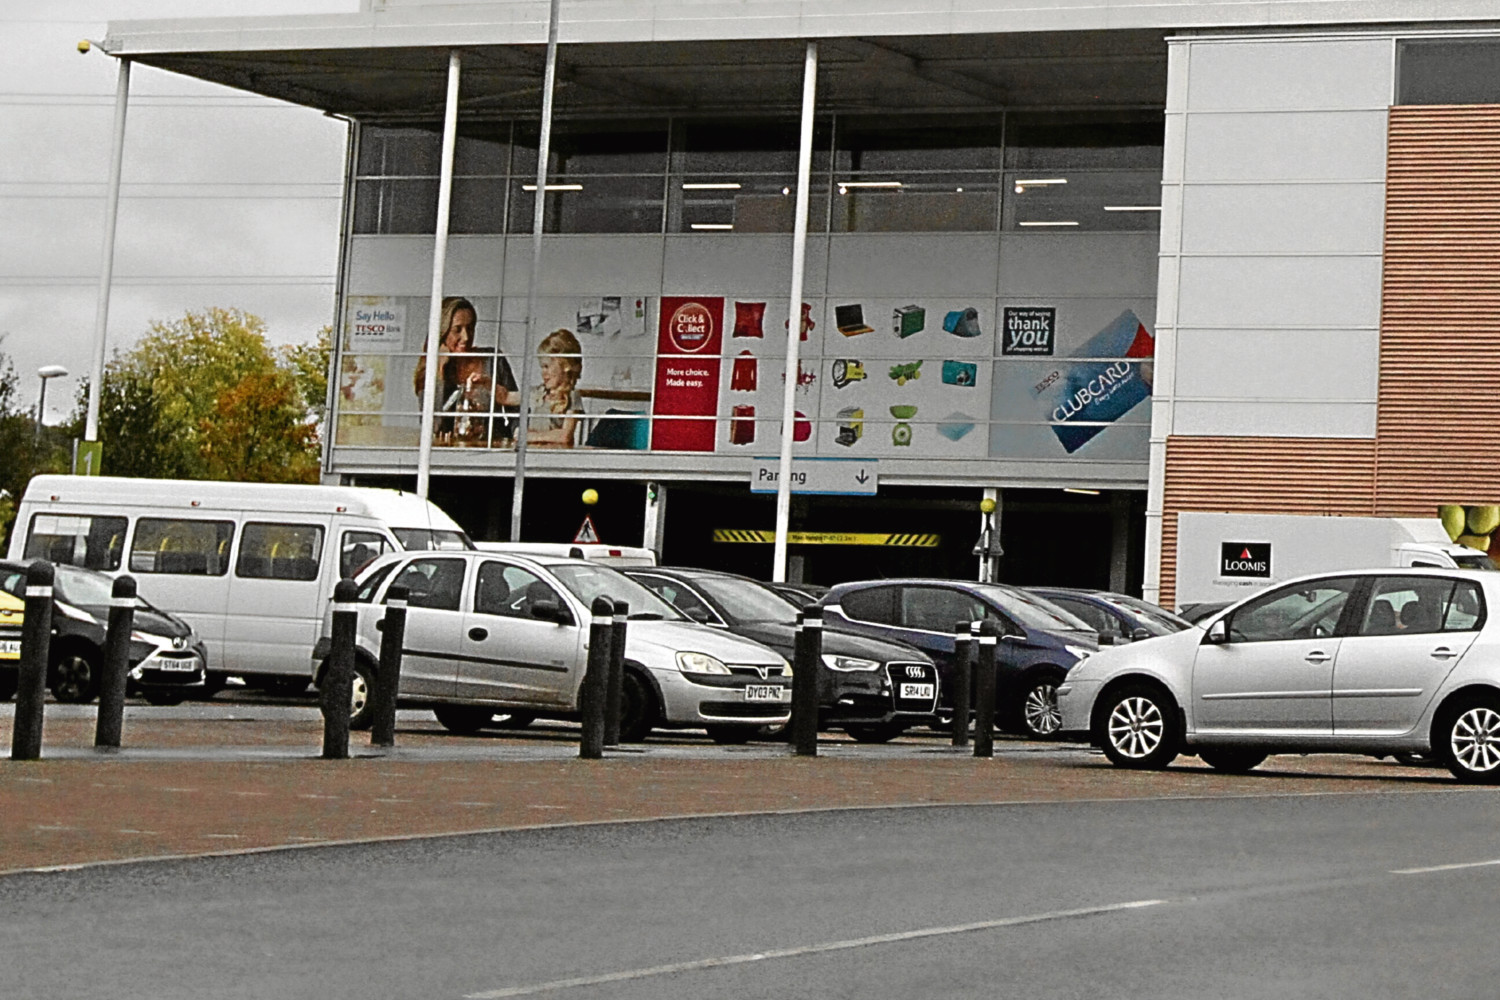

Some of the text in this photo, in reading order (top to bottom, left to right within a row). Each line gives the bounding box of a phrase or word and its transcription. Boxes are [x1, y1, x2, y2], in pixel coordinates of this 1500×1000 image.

[356, 311, 395, 322] Say Hello
[678, 314, 704, 323] Click &
[1008, 316, 1049, 330] thank
[355, 325, 385, 333] TESCO
[1010, 330, 1049, 347] you
[666, 368, 684, 376] More
[1035, 371, 1059, 392] TESCO
[1052, 361, 1130, 422] CLUBCARD
[84, 451, 93, 475] 1
[759, 468, 806, 485] Parng
[1225, 559, 1266, 572] LOOMIS
